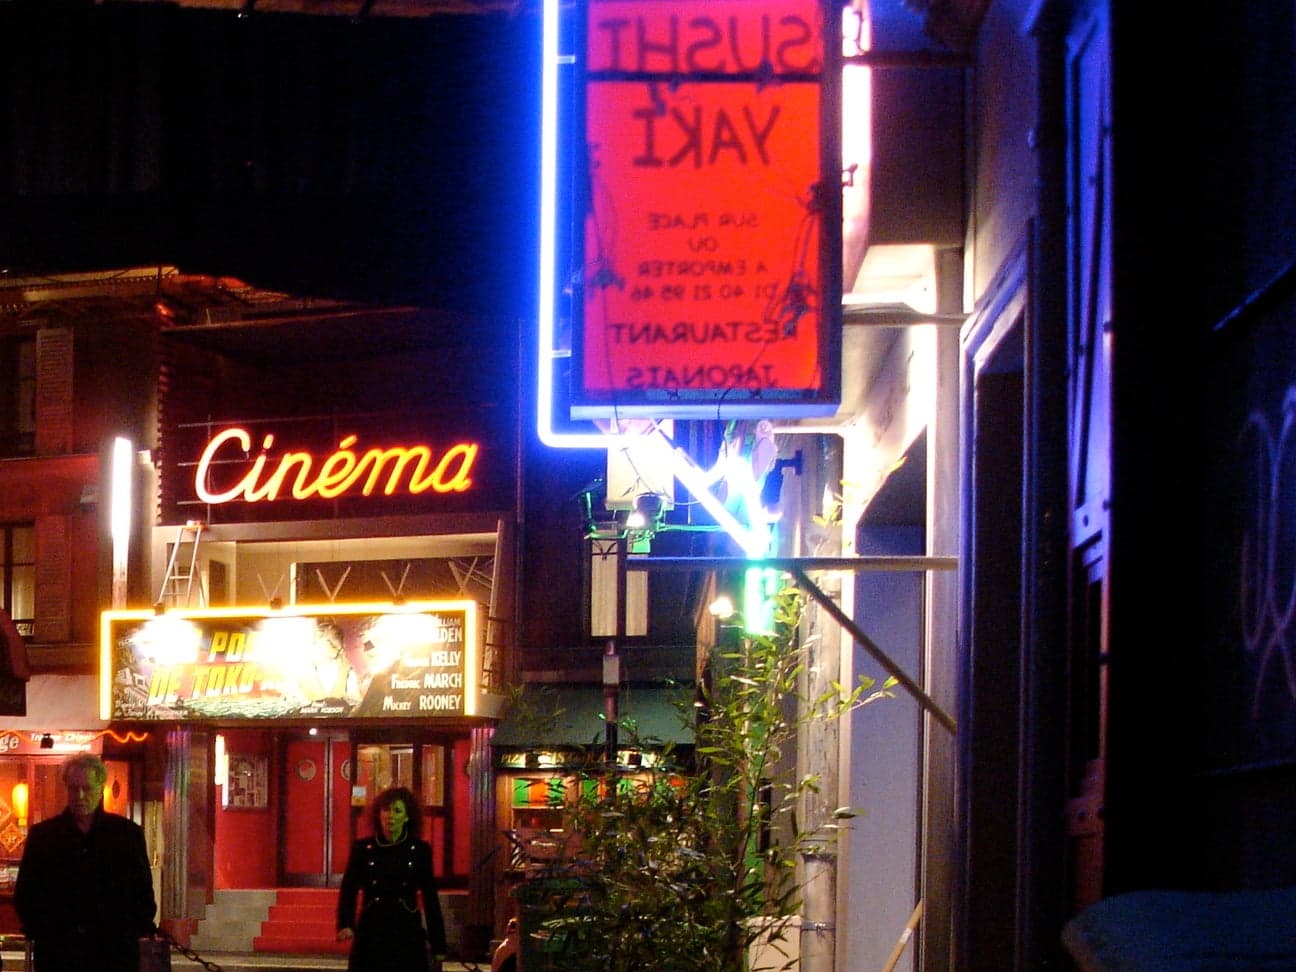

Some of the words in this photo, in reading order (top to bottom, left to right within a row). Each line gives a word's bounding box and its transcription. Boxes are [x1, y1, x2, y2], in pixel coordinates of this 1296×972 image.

[195, 427, 479, 504] Cinéma
[423, 673, 462, 689] MARCH
[419, 695, 462, 711] ROONEY
